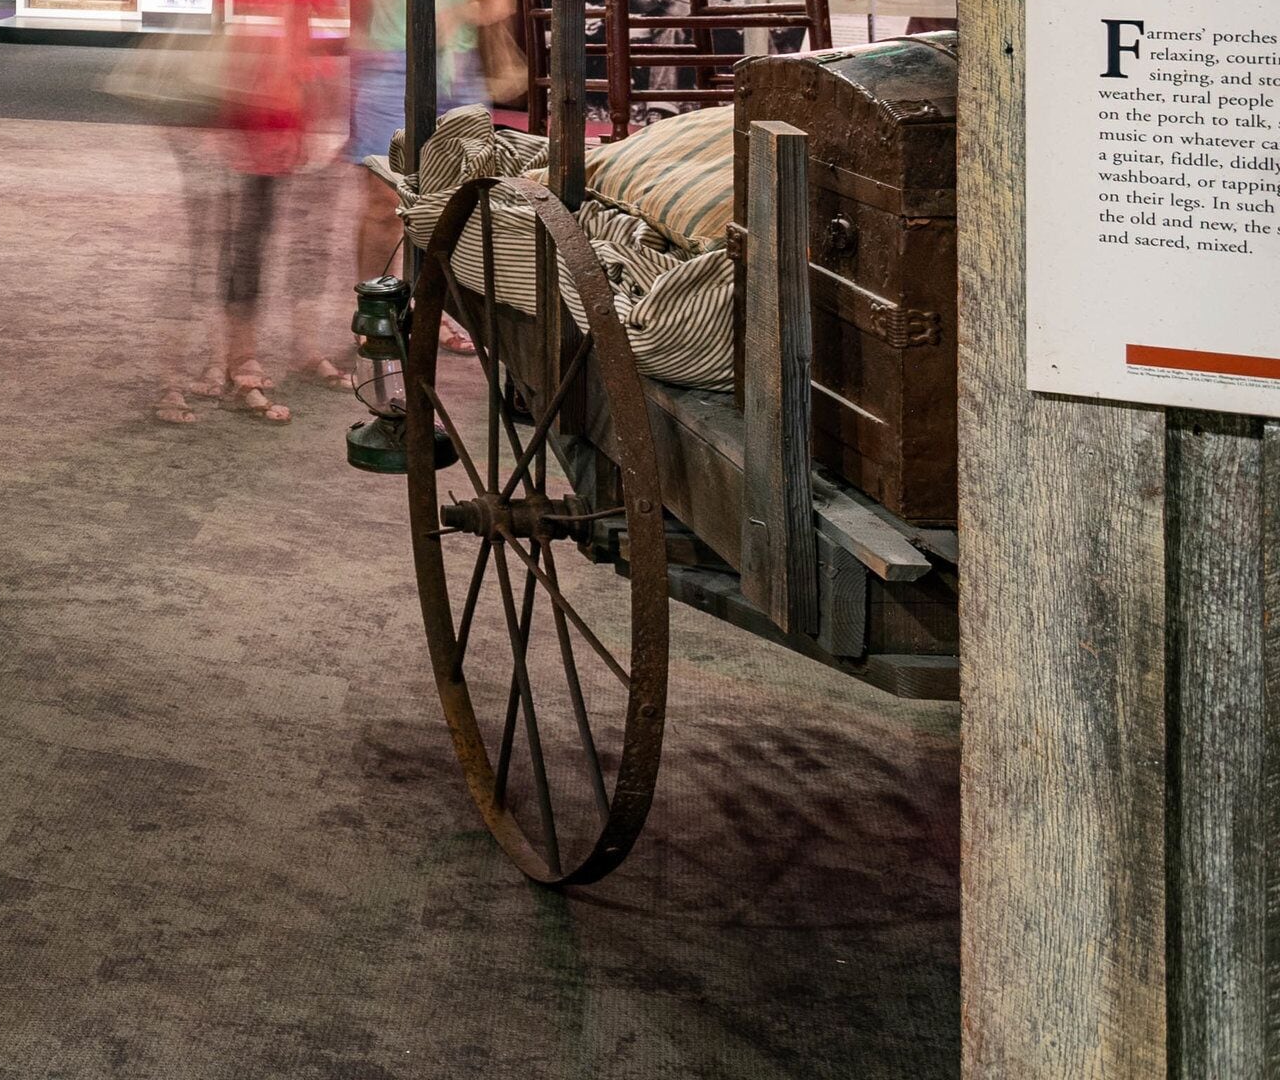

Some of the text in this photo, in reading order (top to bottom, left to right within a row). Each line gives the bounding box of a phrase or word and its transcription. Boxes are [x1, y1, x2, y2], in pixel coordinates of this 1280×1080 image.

[1213, 29, 1278, 46] porches
[1150, 47, 1220, 67] relaxing,
[1149, 68, 1214, 88] singing,
[1220, 72, 1252, 86] and
[1098, 88, 1274, 110] weather, rural people
[1098, 107, 1272, 130] on the porch to talk,
[1099, 129, 1147, 143] music
[1152, 134, 1173, 144] on
[1180, 132, 1255, 149] whatever
[1098, 151, 1107, 161] a
[1112, 150, 1164, 166] guitar,
[1171, 151, 1223, 169] fiddle,
[1099, 170, 1191, 188] washboard,
[1197, 178, 1216, 188] or
[1098, 190, 1275, 214] on their legs. In such
[1099, 209, 1272, 235] the old and new, the
[1098, 231, 1254, 255] and sacred, mixed.
